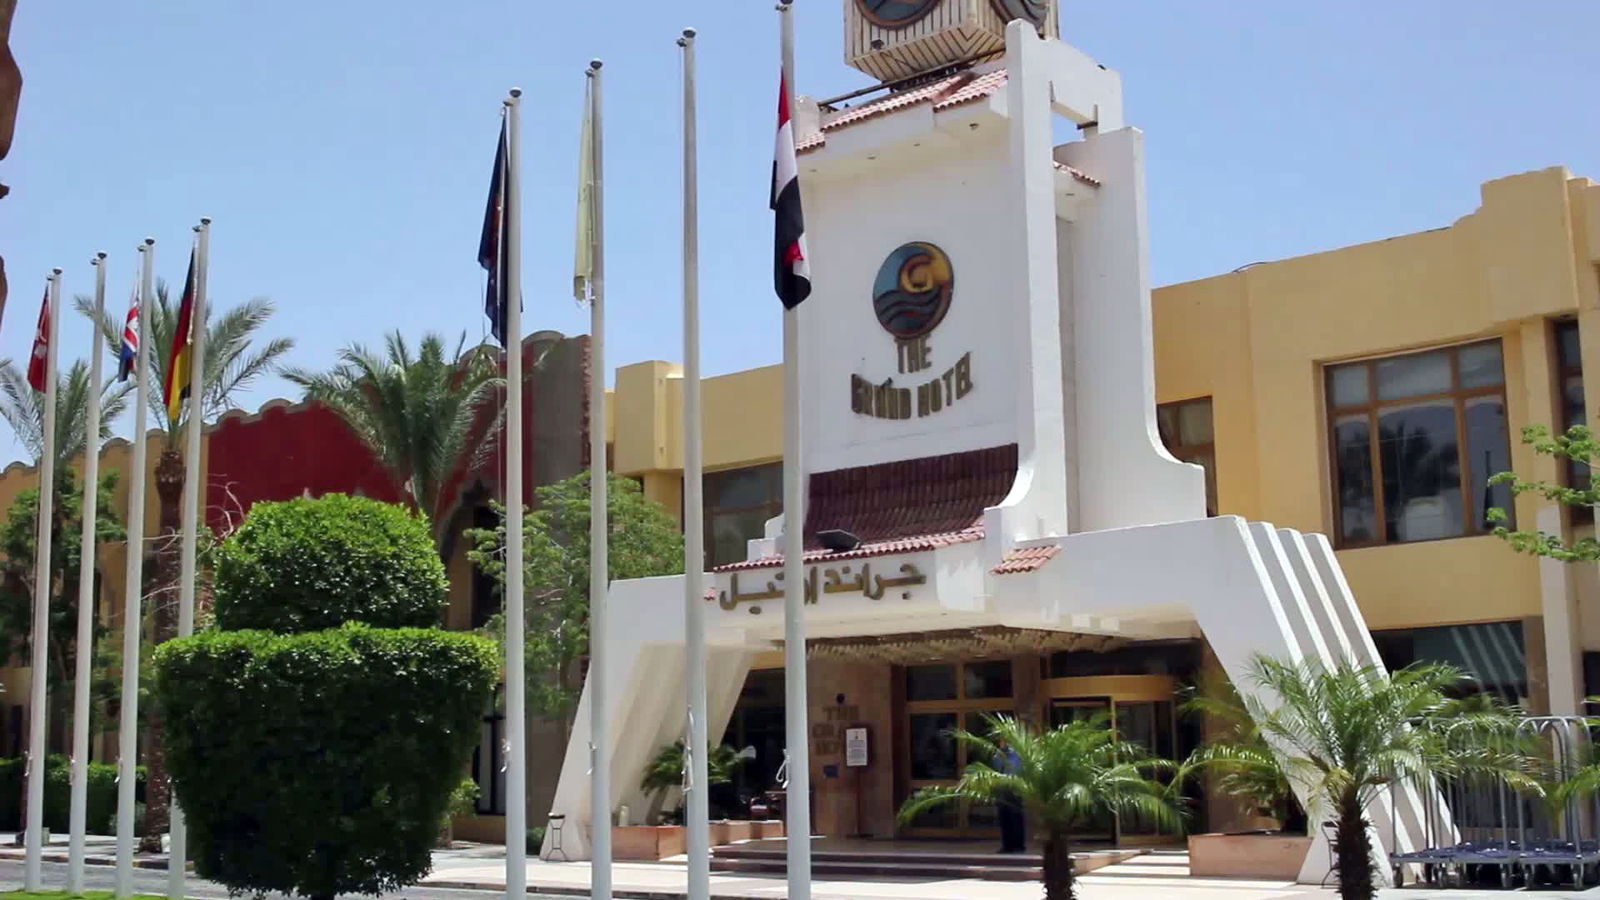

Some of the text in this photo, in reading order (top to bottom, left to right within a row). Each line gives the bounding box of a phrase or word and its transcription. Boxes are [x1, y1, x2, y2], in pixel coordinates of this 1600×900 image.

[894, 334, 932, 374] THE
[851, 351, 974, 420] GRAND HOTEL
